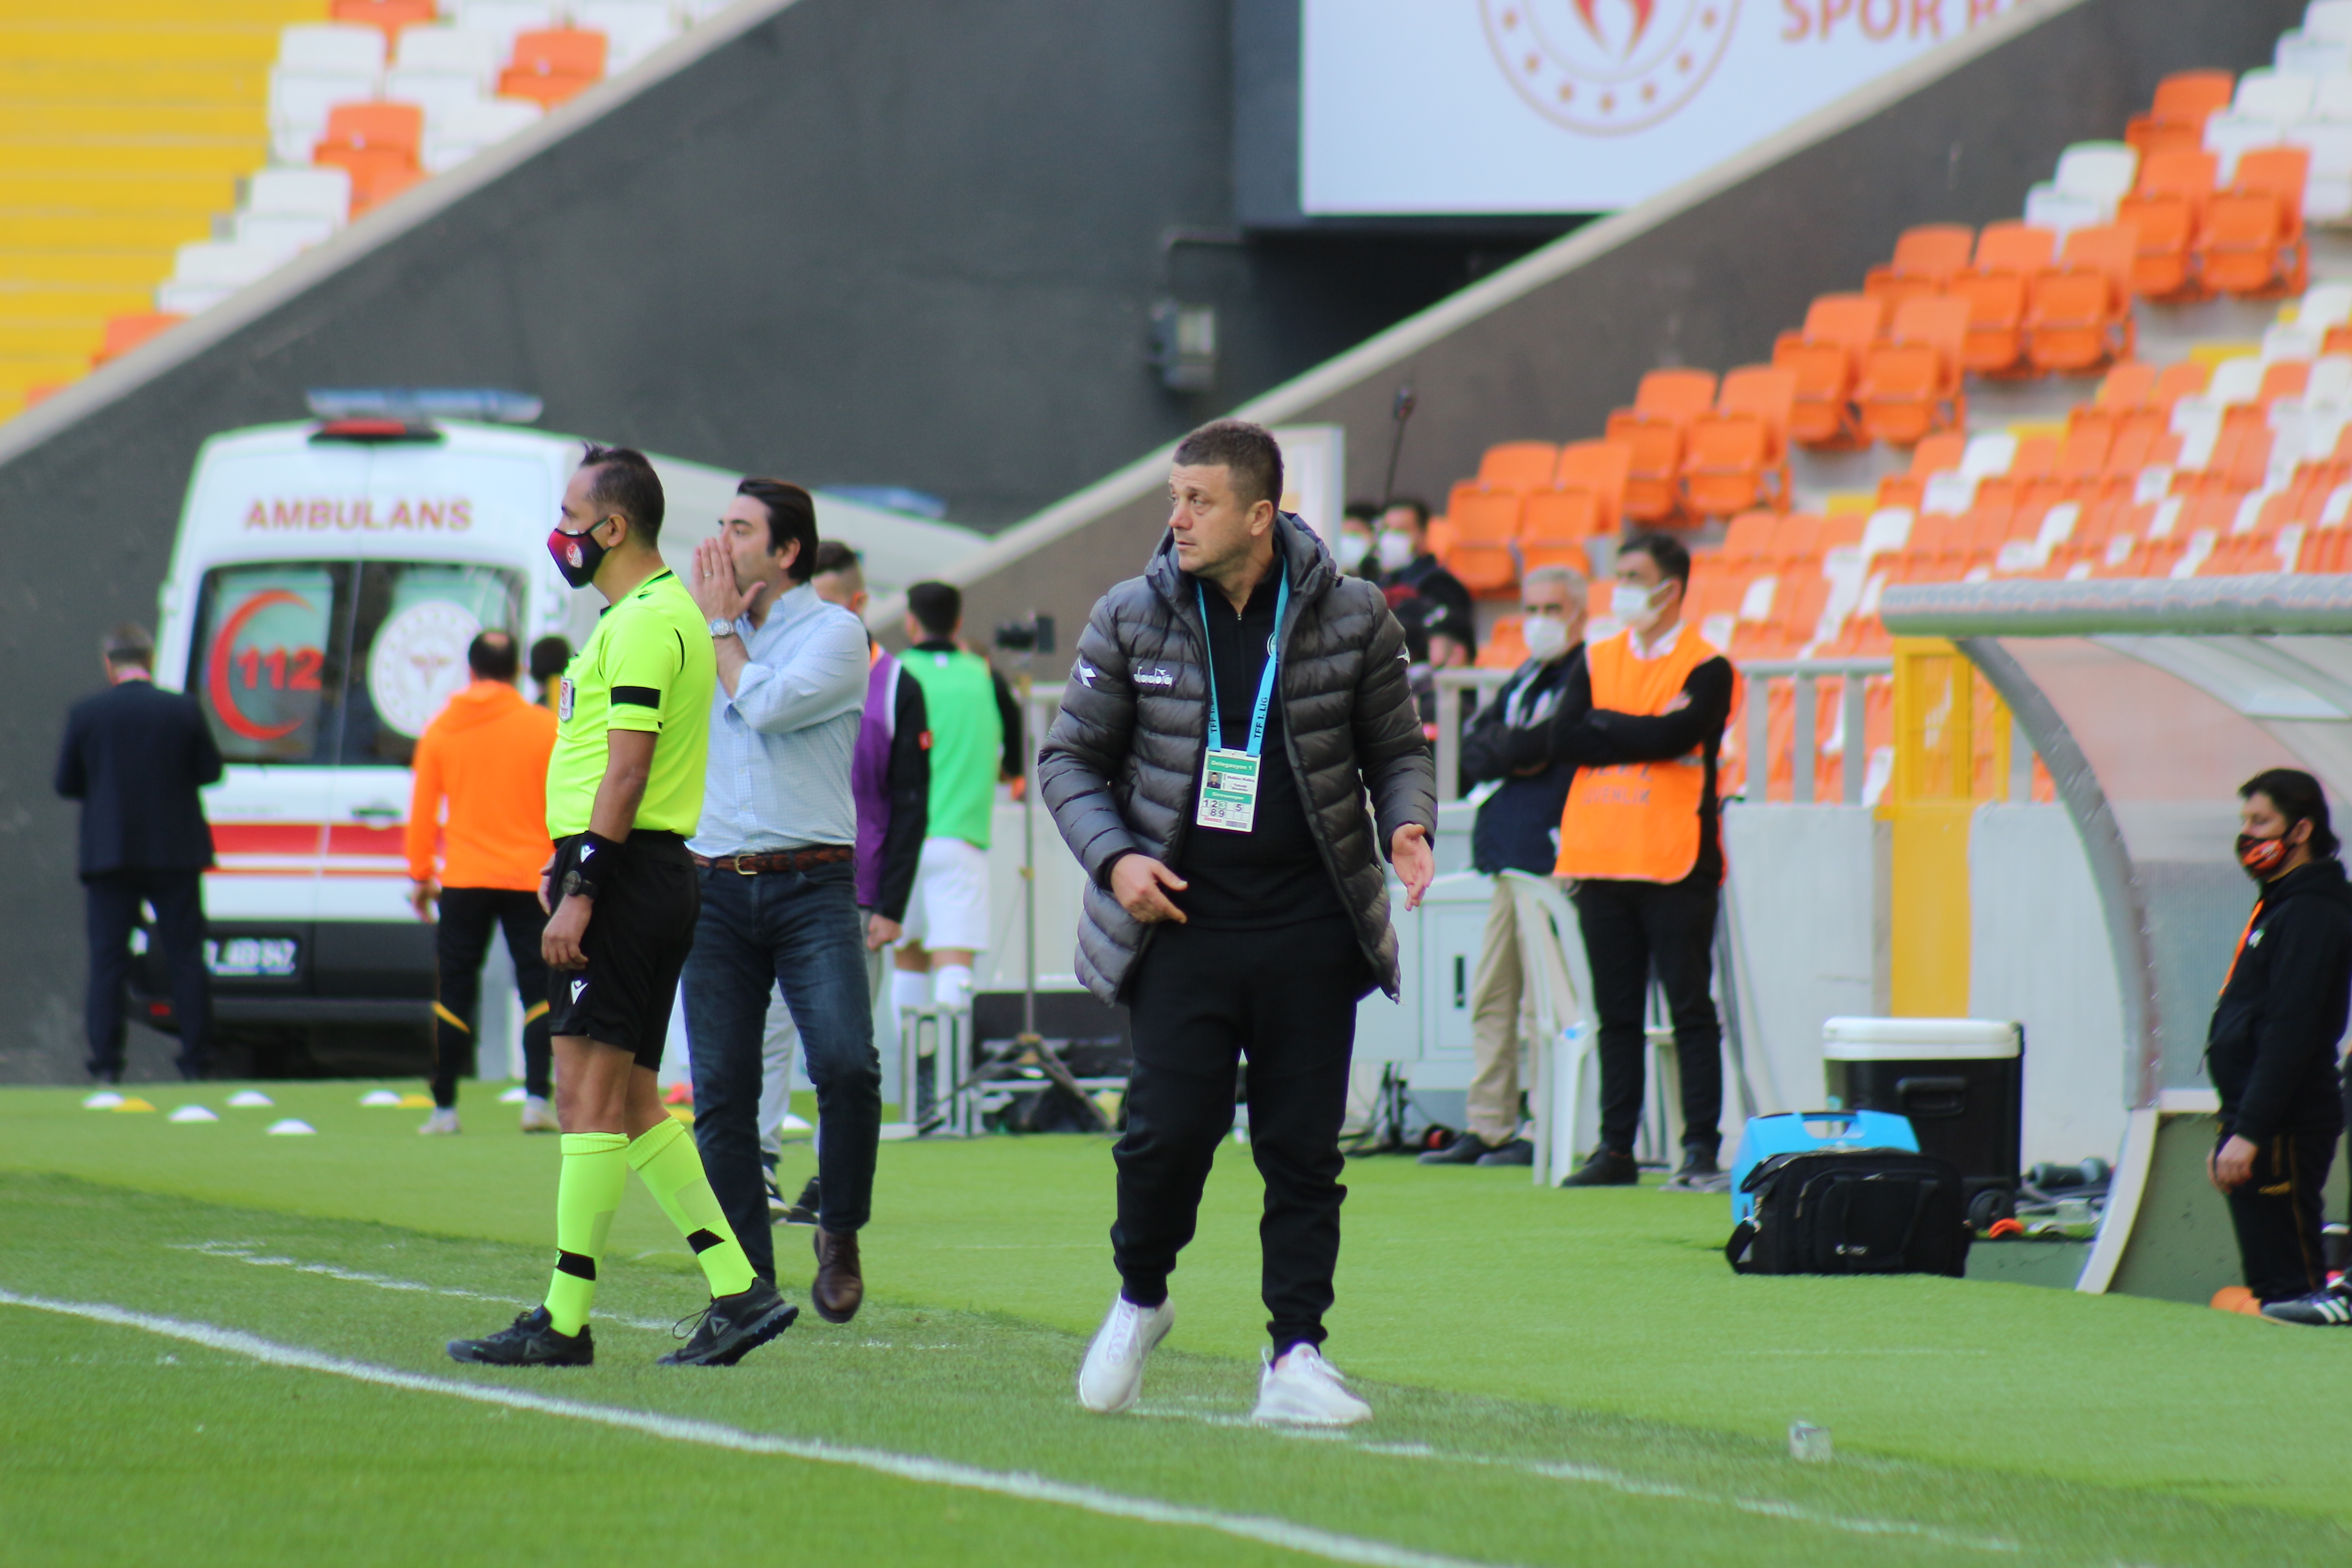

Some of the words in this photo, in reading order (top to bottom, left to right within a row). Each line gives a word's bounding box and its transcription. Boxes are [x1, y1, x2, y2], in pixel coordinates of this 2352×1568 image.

[1781, 0, 1943, 42] SPOR
[245, 498, 473, 531] AMBULANS
[237, 646, 324, 690] 112
[1254, 722, 1263, 738] TFF
